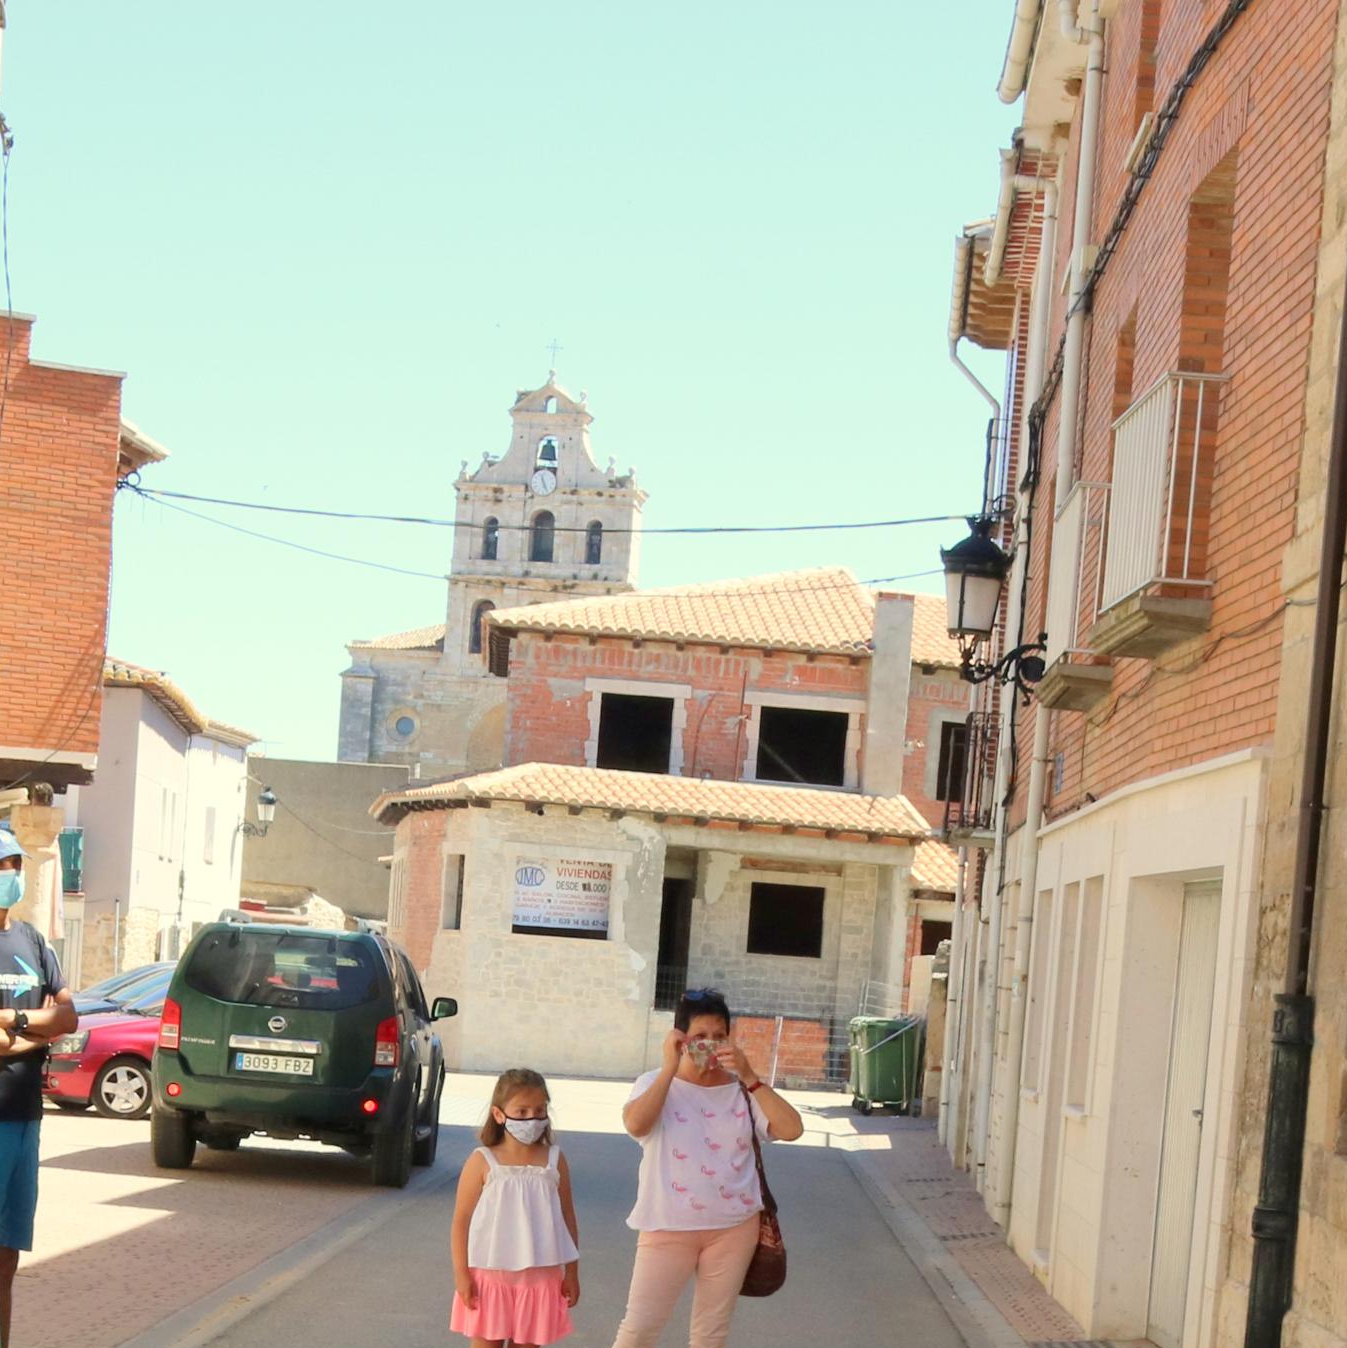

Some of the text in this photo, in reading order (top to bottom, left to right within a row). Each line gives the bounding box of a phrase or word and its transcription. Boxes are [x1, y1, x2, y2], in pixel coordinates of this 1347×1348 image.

[556, 867, 612, 881] VIVIENDAS
[556, 881, 579, 891] DESDE
[244, 1055, 311, 1073] 3093 FBZ
